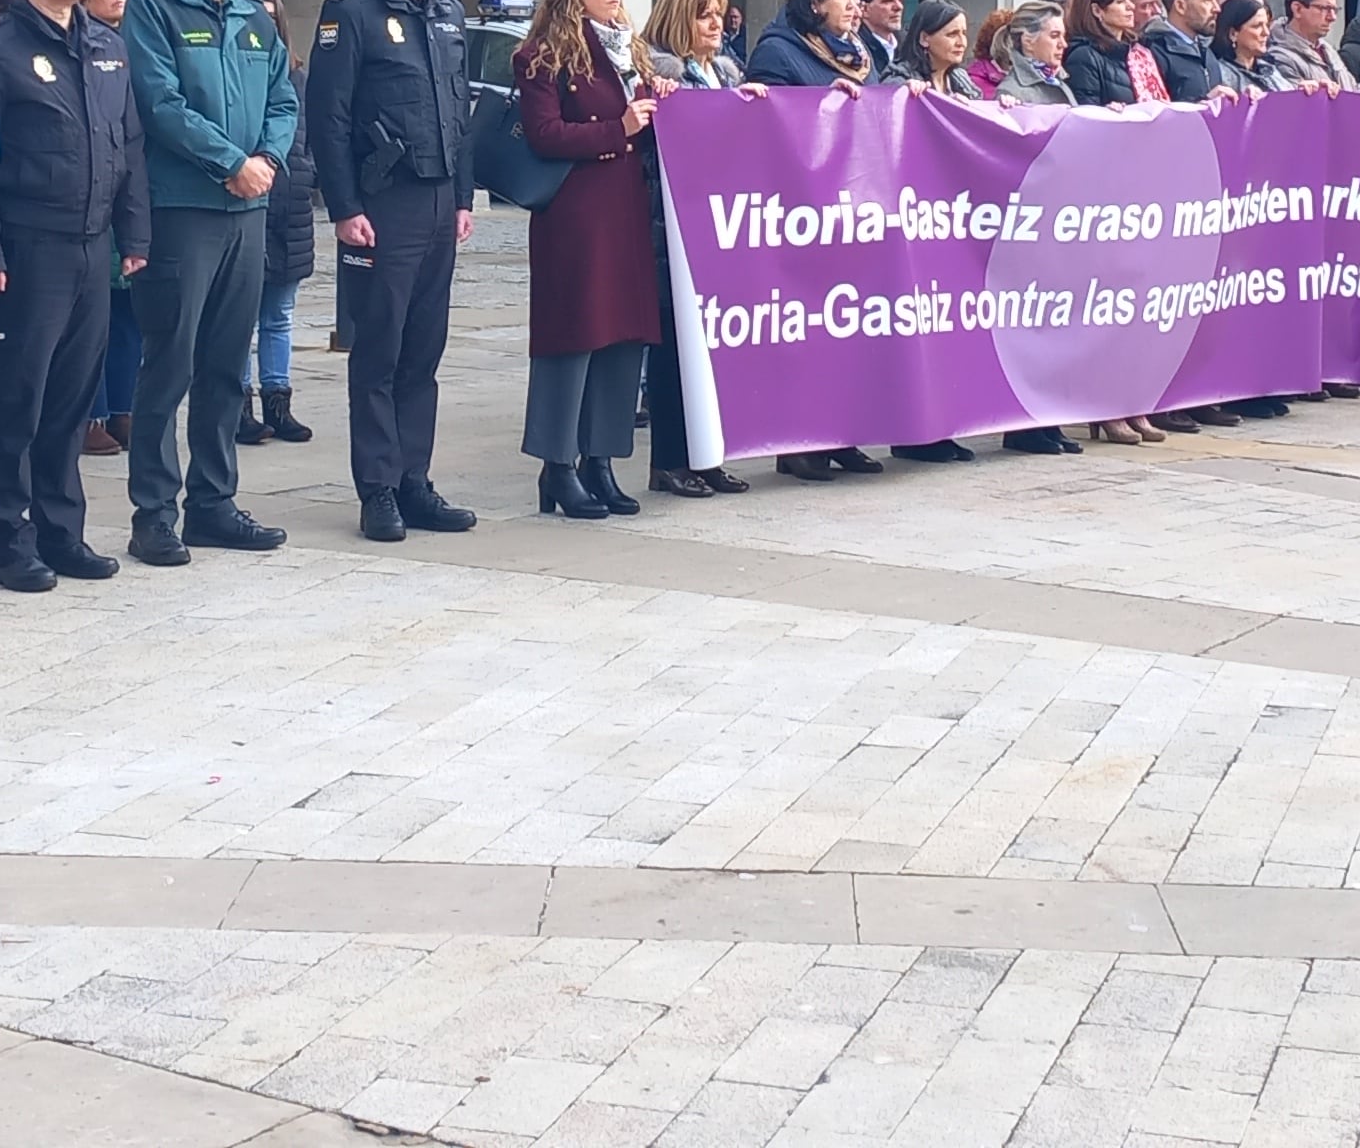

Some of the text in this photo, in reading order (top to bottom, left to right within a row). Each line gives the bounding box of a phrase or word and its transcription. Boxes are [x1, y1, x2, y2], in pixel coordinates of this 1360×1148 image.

[708, 186, 1043, 250] Vitoria-Gasteiz
[1053, 202, 1163, 242] eraso
[1172, 180, 1314, 238] matxisten
[695, 278, 954, 351] itoria-Gasteiz
[959, 280, 1074, 332] contra
[1082, 278, 1136, 326] las
[1142, 266, 1286, 334] agresiones
